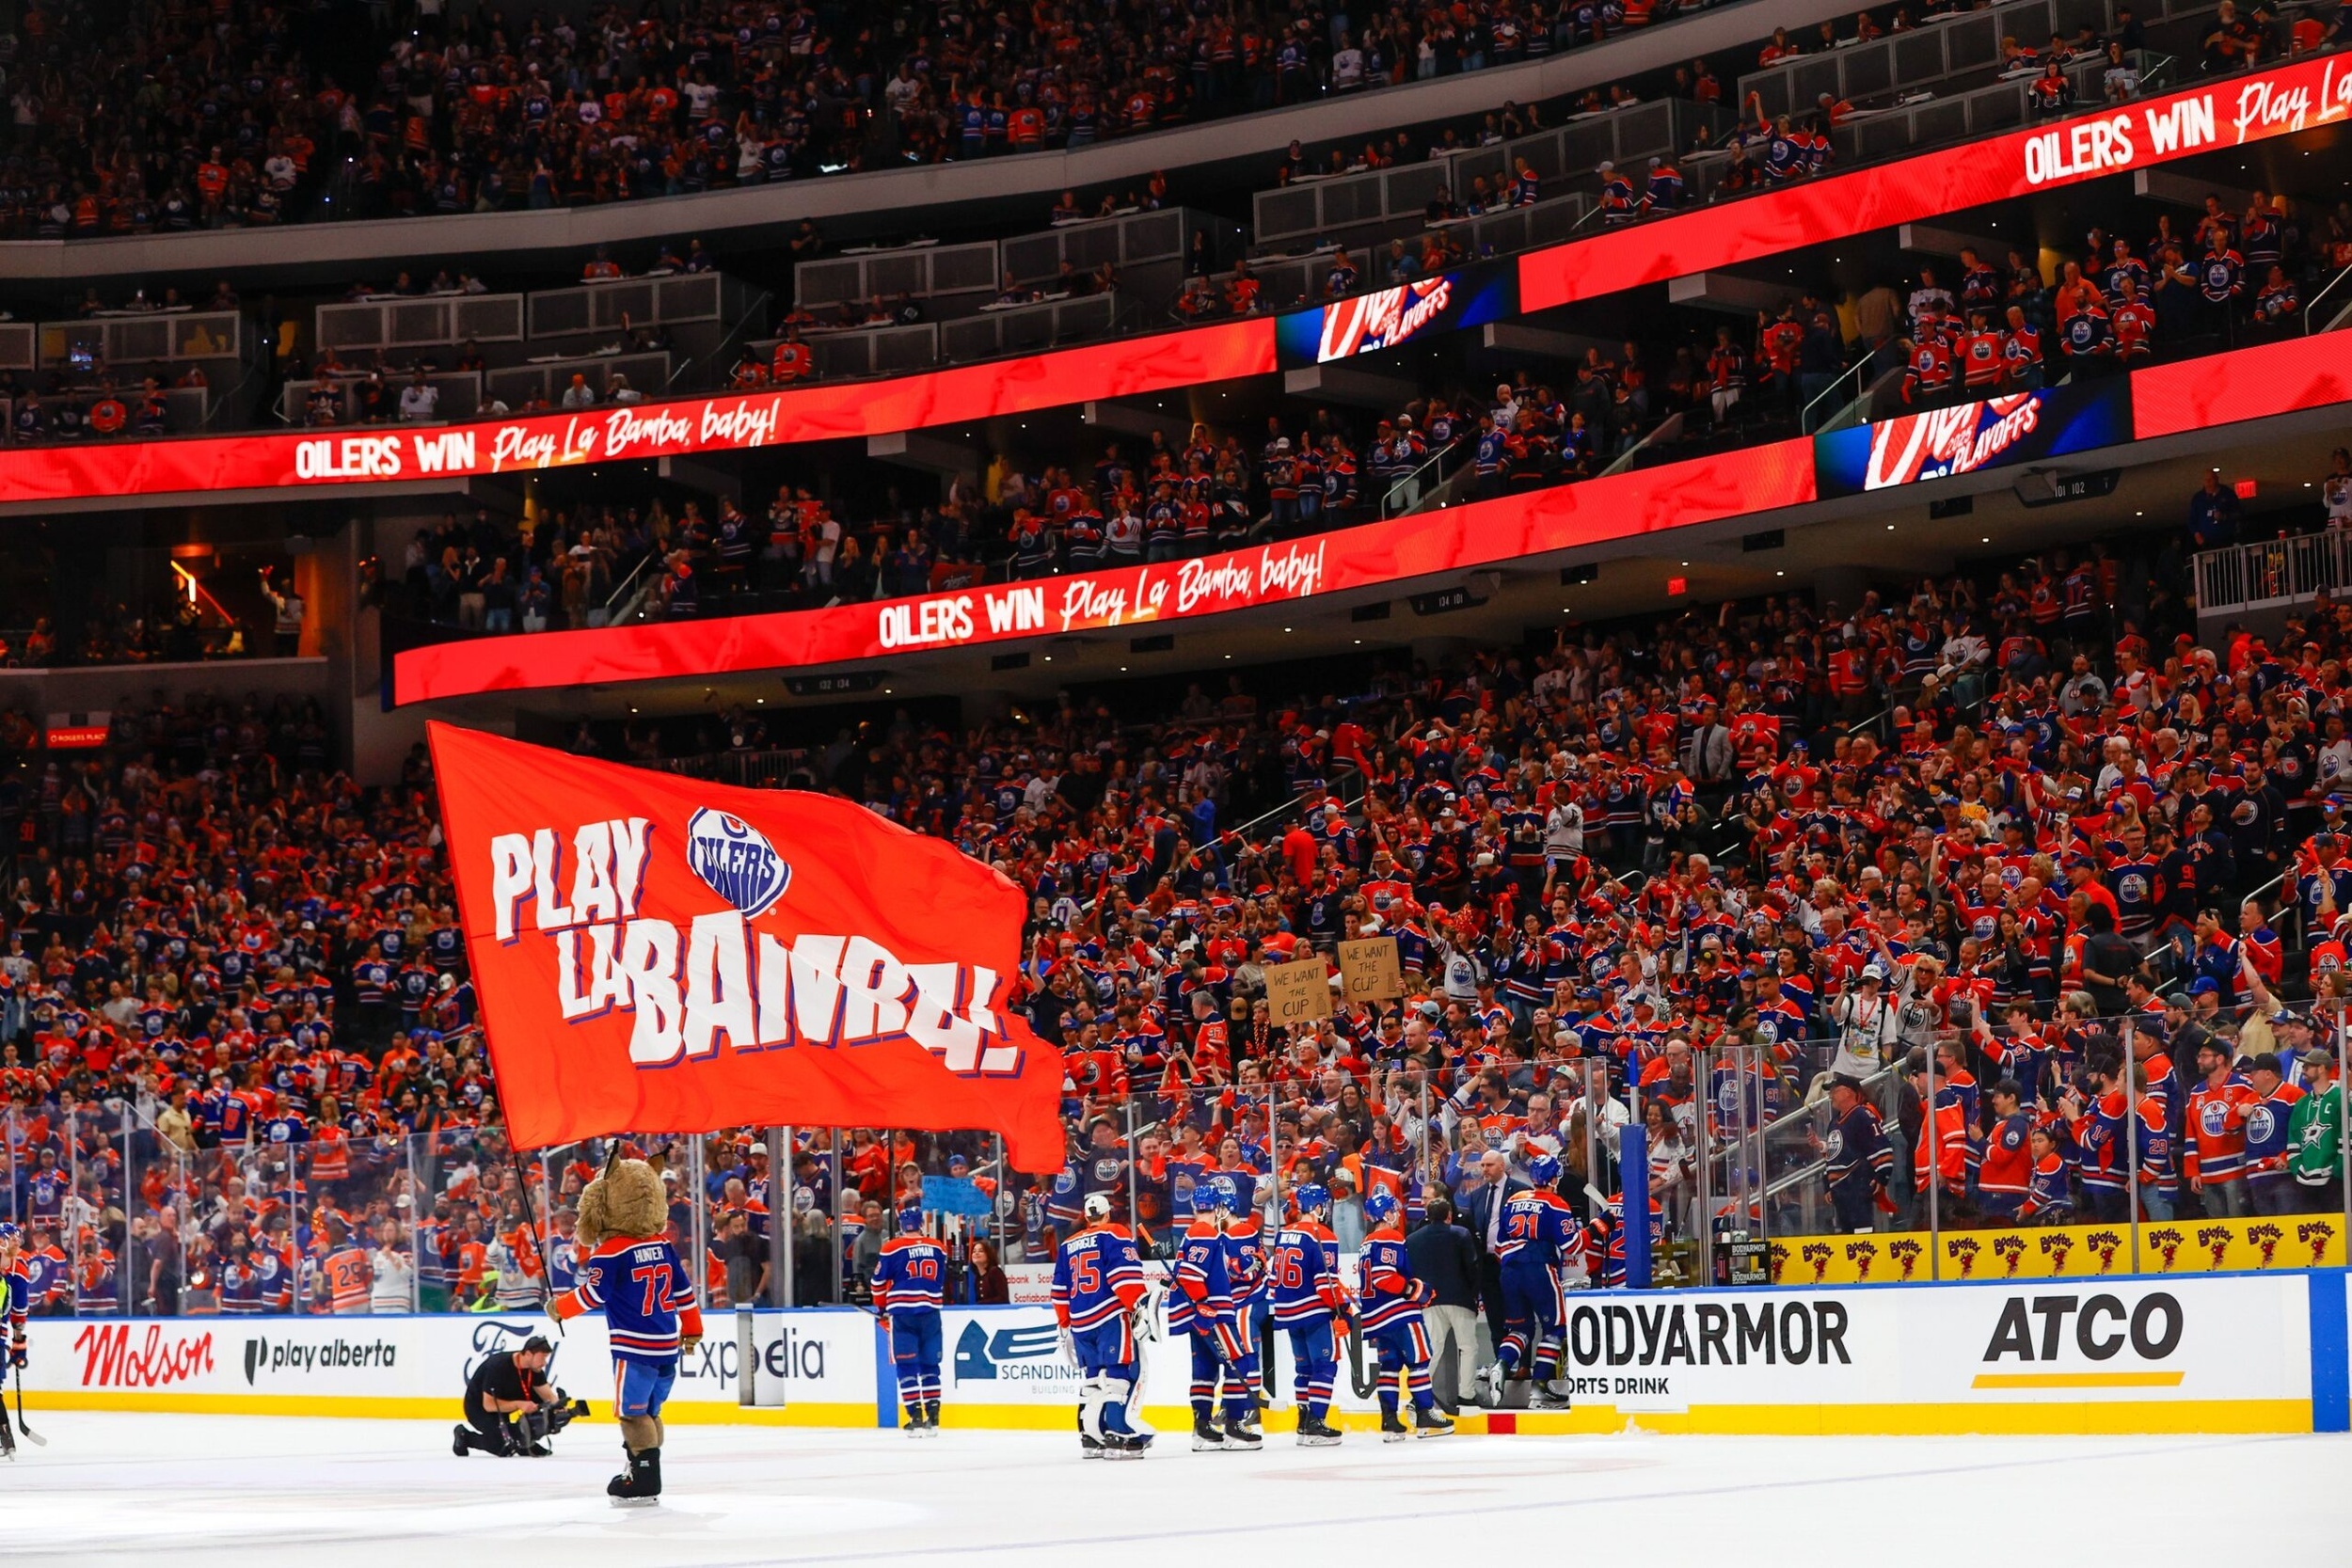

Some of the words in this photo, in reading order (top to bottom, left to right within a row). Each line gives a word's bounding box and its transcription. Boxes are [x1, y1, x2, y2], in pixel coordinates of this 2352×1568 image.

[2025, 114, 2134, 184] OILERS
[2145, 94, 2216, 155] WIN
[2233, 82, 2312, 145] Play
[1382, 280, 1454, 348] PLAYOFFS
[295, 436, 401, 479] OILERS
[413, 431, 475, 473] WIN
[490, 425, 556, 474] Play
[562, 417, 598, 463] La
[604, 408, 692, 458] Bamba,
[700, 397, 781, 448] baby!
[1950, 397, 2042, 475] PLAYOFFS
[2072, 482, 2086, 495] 102
[879, 598, 974, 648] OILERS
[984, 586, 1045, 634] WIN
[1058, 578, 1129, 631] Play
[1131, 568, 1170, 621] La
[1176, 557, 1253, 613] Bamba,
[1259, 539, 1327, 597] baby!
[490, 816, 658, 946] PLAY
[1346, 947, 1360, 961] WE
[1364, 944, 1390, 958] WANT
[556, 922, 640, 1024] LA
[1359, 960, 1377, 973] THE
[1274, 972, 1288, 987] WE
[1294, 967, 1320, 983] WANT
[1352, 976, 1379, 993] CUP
[1288, 988, 1307, 997] THE
[1282, 998, 1310, 1017] CUP
[2090, 1125, 2110, 1141] 14
[2149, 1138, 2168, 1155] 29
[633, 1246, 664, 1263] HUNTER
[908, 1246, 934, 1259] HYMAN
[1187, 1246, 1210, 1263] 27
[1380, 1247, 1398, 1265] 51
[587, 1267, 603, 1287] 2
[631, 1262, 677, 1317] 72
[1013, 1293, 1052, 1304] Scotiaban
[1571, 1301, 1852, 1368] ODYARMOR
[1982, 1291, 2184, 1362] ATCO
[74, 1324, 215, 1388] Molson
[273, 1339, 316, 1373] play
[320, 1338, 396, 1368] alberta
[1031, 1386, 1075, 1395] BUILDING
[1568, 1378, 1610, 1395] ORTS
[1614, 1378, 1670, 1395] DRINK
